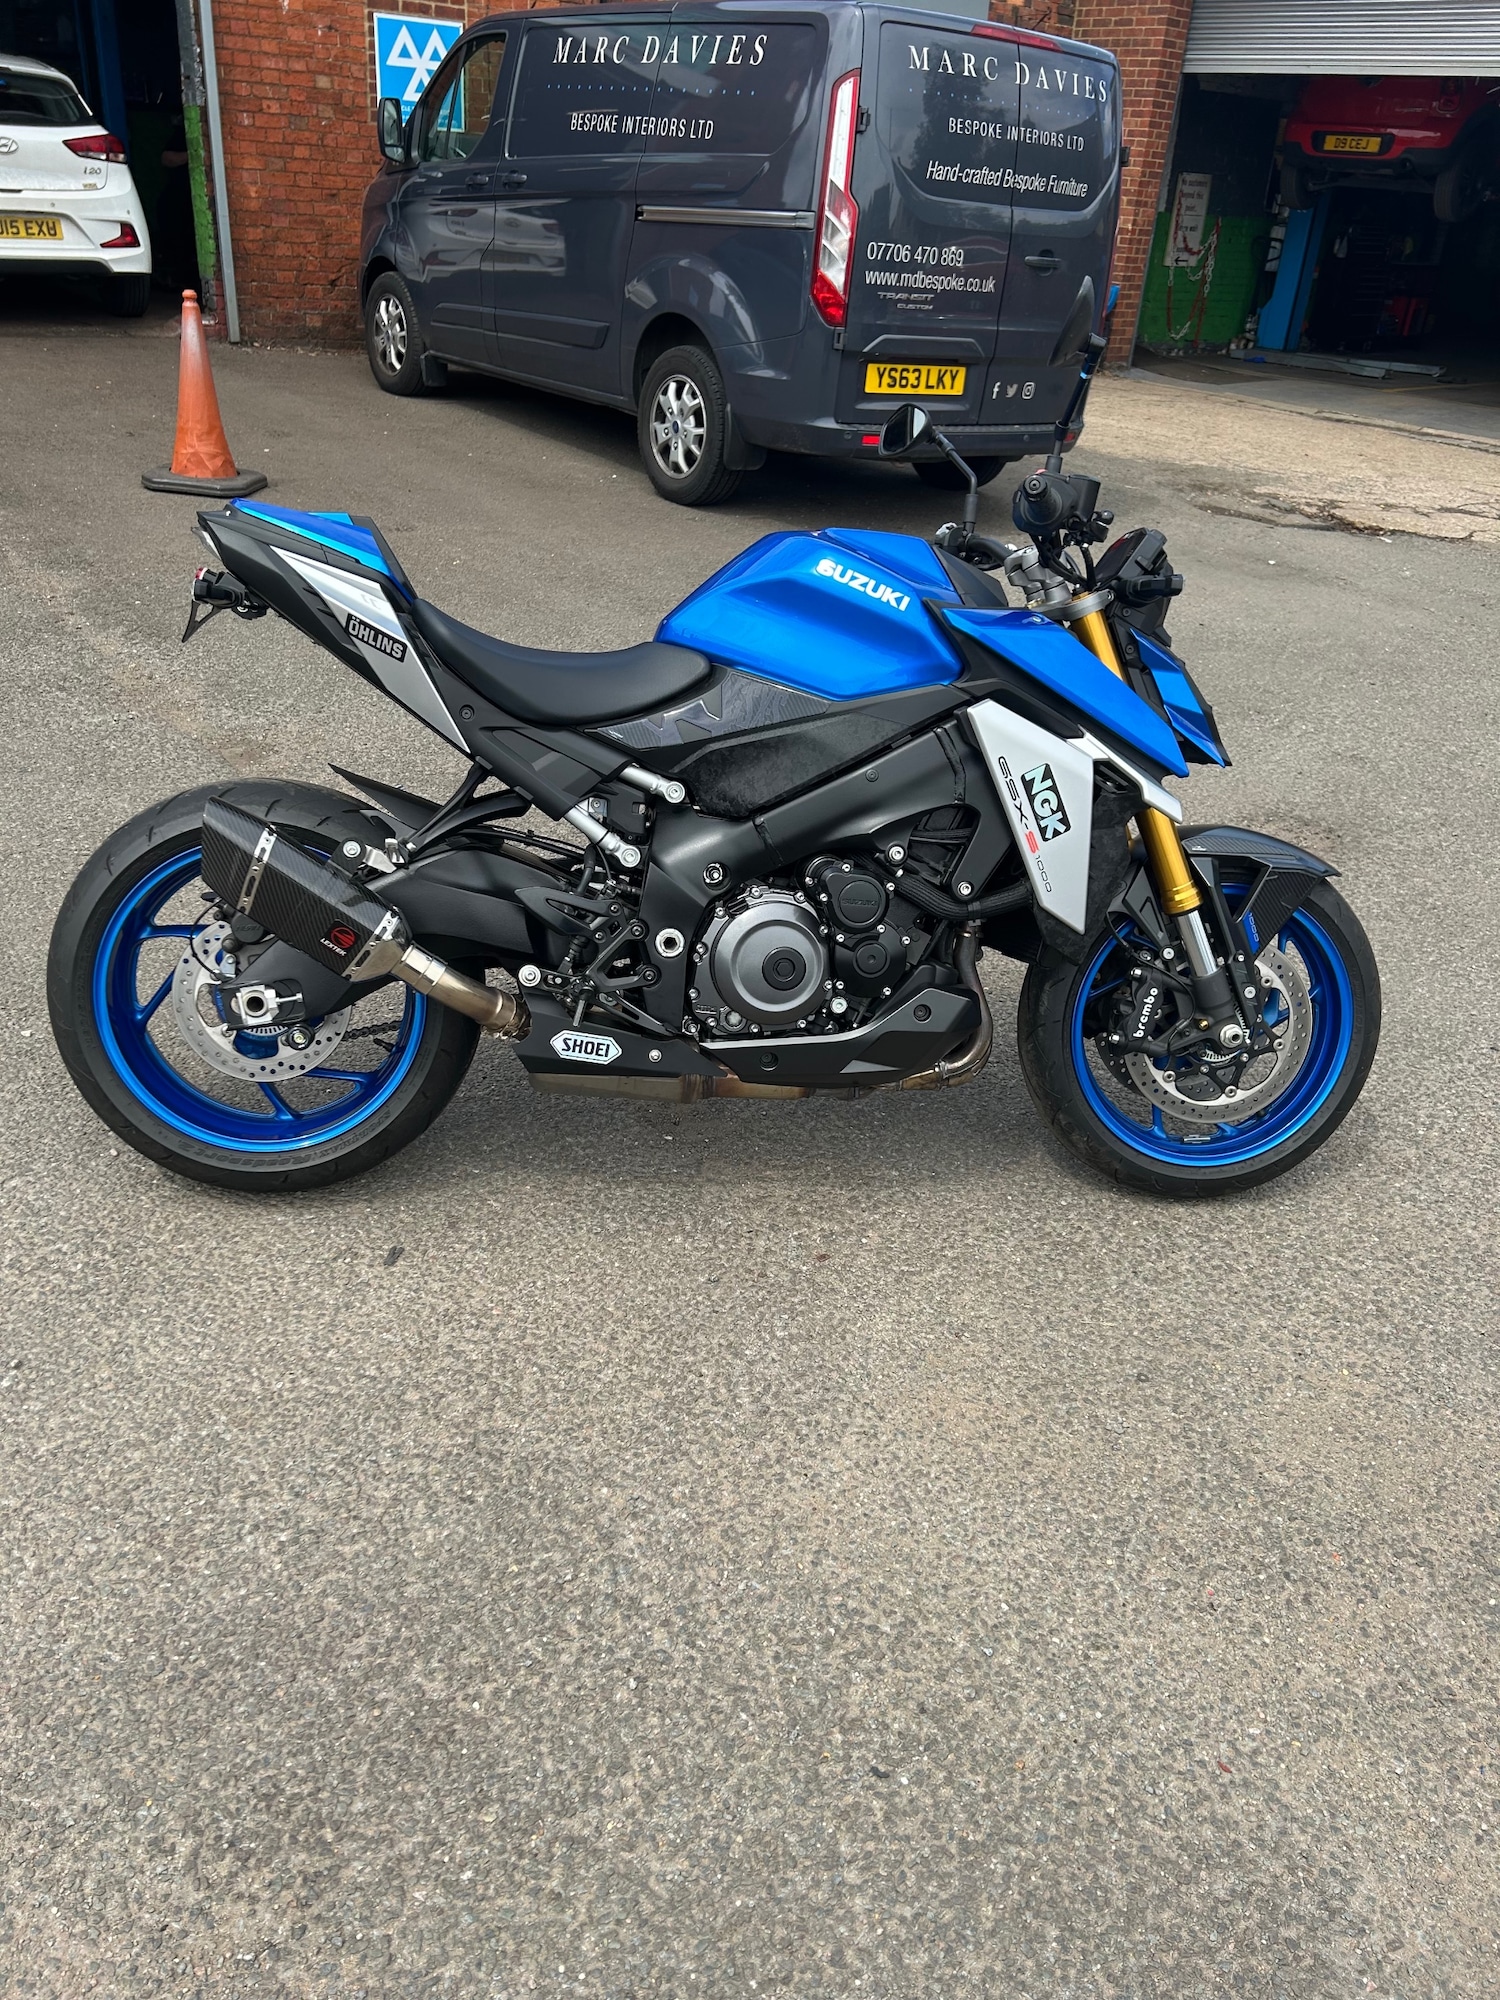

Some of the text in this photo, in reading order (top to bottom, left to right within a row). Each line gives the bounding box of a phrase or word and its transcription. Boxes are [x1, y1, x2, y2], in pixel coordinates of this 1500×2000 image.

[552, 34, 768, 66] MARC DAVIES
[908, 45, 1108, 103] MARC DAVIES
[570, 112, 715, 140] BESPOKE INTERIORS LTD
[948, 117, 1085, 151] BESPOKE INTERIORS LTD
[926, 160, 1089, 198] Hand-crafted Bespoke Furniture
[867, 241, 964, 267] 07706 470 869
[865, 270, 996, 293] www.mdbespoke.co.uk
[877, 292, 935, 301] TRANSIT
[876, 366, 960, 390] YS63 LKY
[815, 557, 911, 612] SUZUKI
[348, 615, 404, 660] ÖHLINS
[1022, 763, 1068, 840] NGK
[319, 937, 348, 957] LEXTEK
[1132, 987, 1159, 1038] brembo
[561, 1037, 611, 1058] SHOEI
